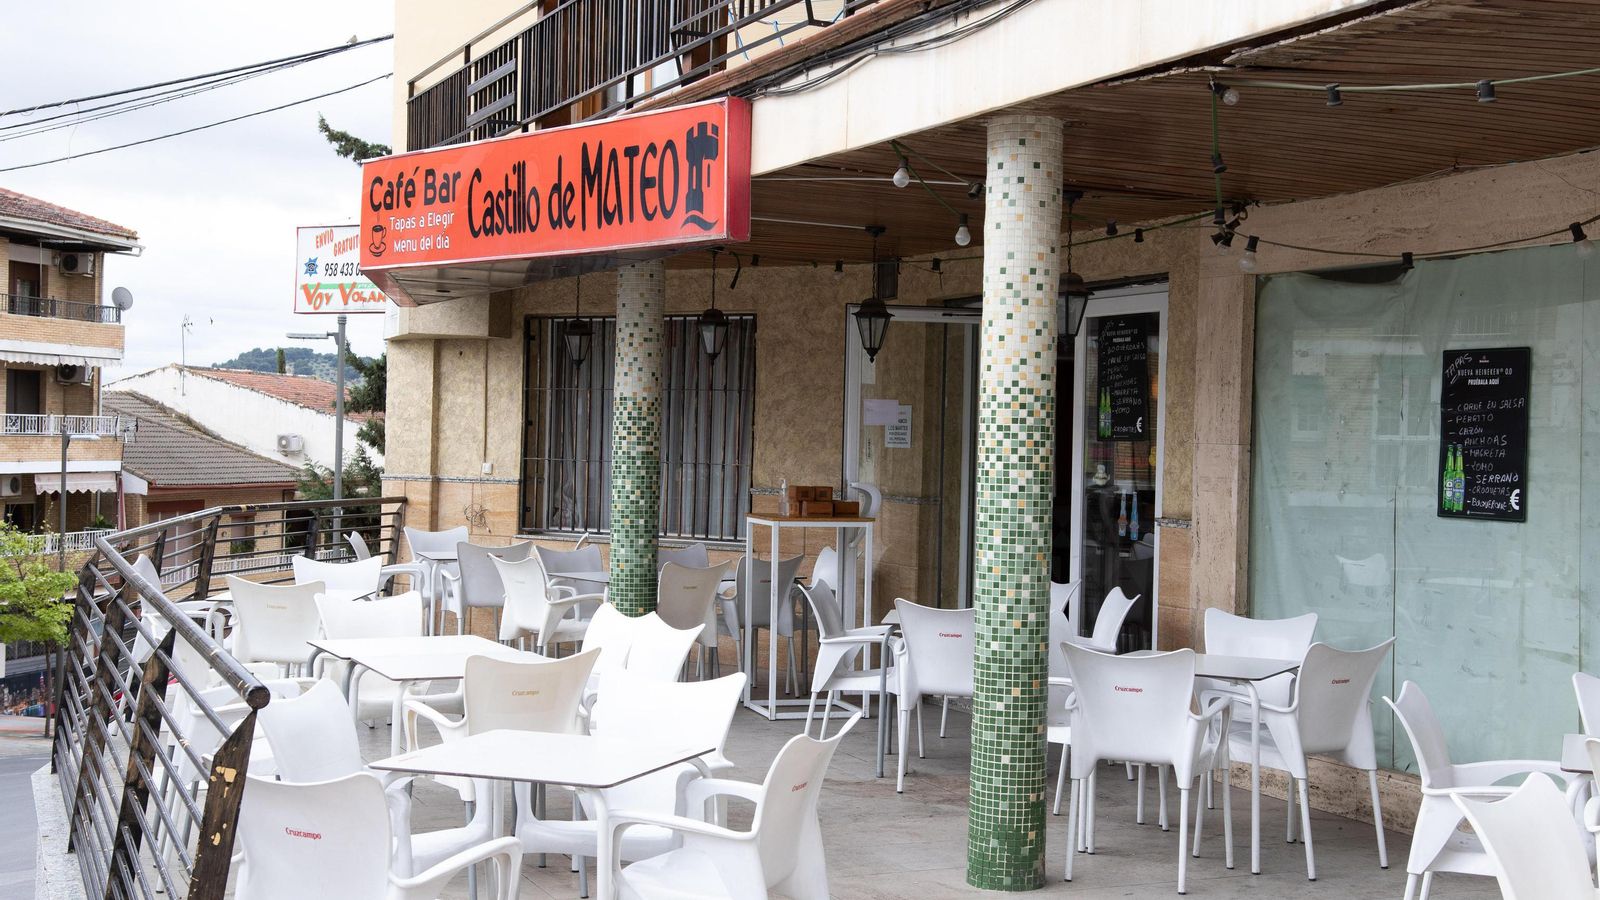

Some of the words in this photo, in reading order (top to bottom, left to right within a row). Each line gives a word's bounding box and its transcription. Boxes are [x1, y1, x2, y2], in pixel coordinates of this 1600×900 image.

[370, 166, 420, 212] Café
[424, 168, 462, 206] Bar
[467, 160, 541, 239] Castillo
[548, 155, 576, 231] de
[582, 139, 680, 232] MATEO
[390, 216, 416, 232] Tapas
[419, 216, 425, 228] a
[427, 210, 455, 229] Elegir
[315, 228, 334, 249] ENVIO
[333, 234, 360, 257] GRATUIT
[420, 235, 434, 250] del
[436, 232, 450, 249] día
[324, 262, 338, 276] 958
[340, 262, 354, 276] 433
[1464, 434, 1508, 447] ANCHOAS
[1475, 472, 1519, 484] SERRANO
[1509, 488, 1521, 511] €
[1114, 685, 1144, 693] Cruzcampo
[285, 826, 322, 841] Cruzcampo
